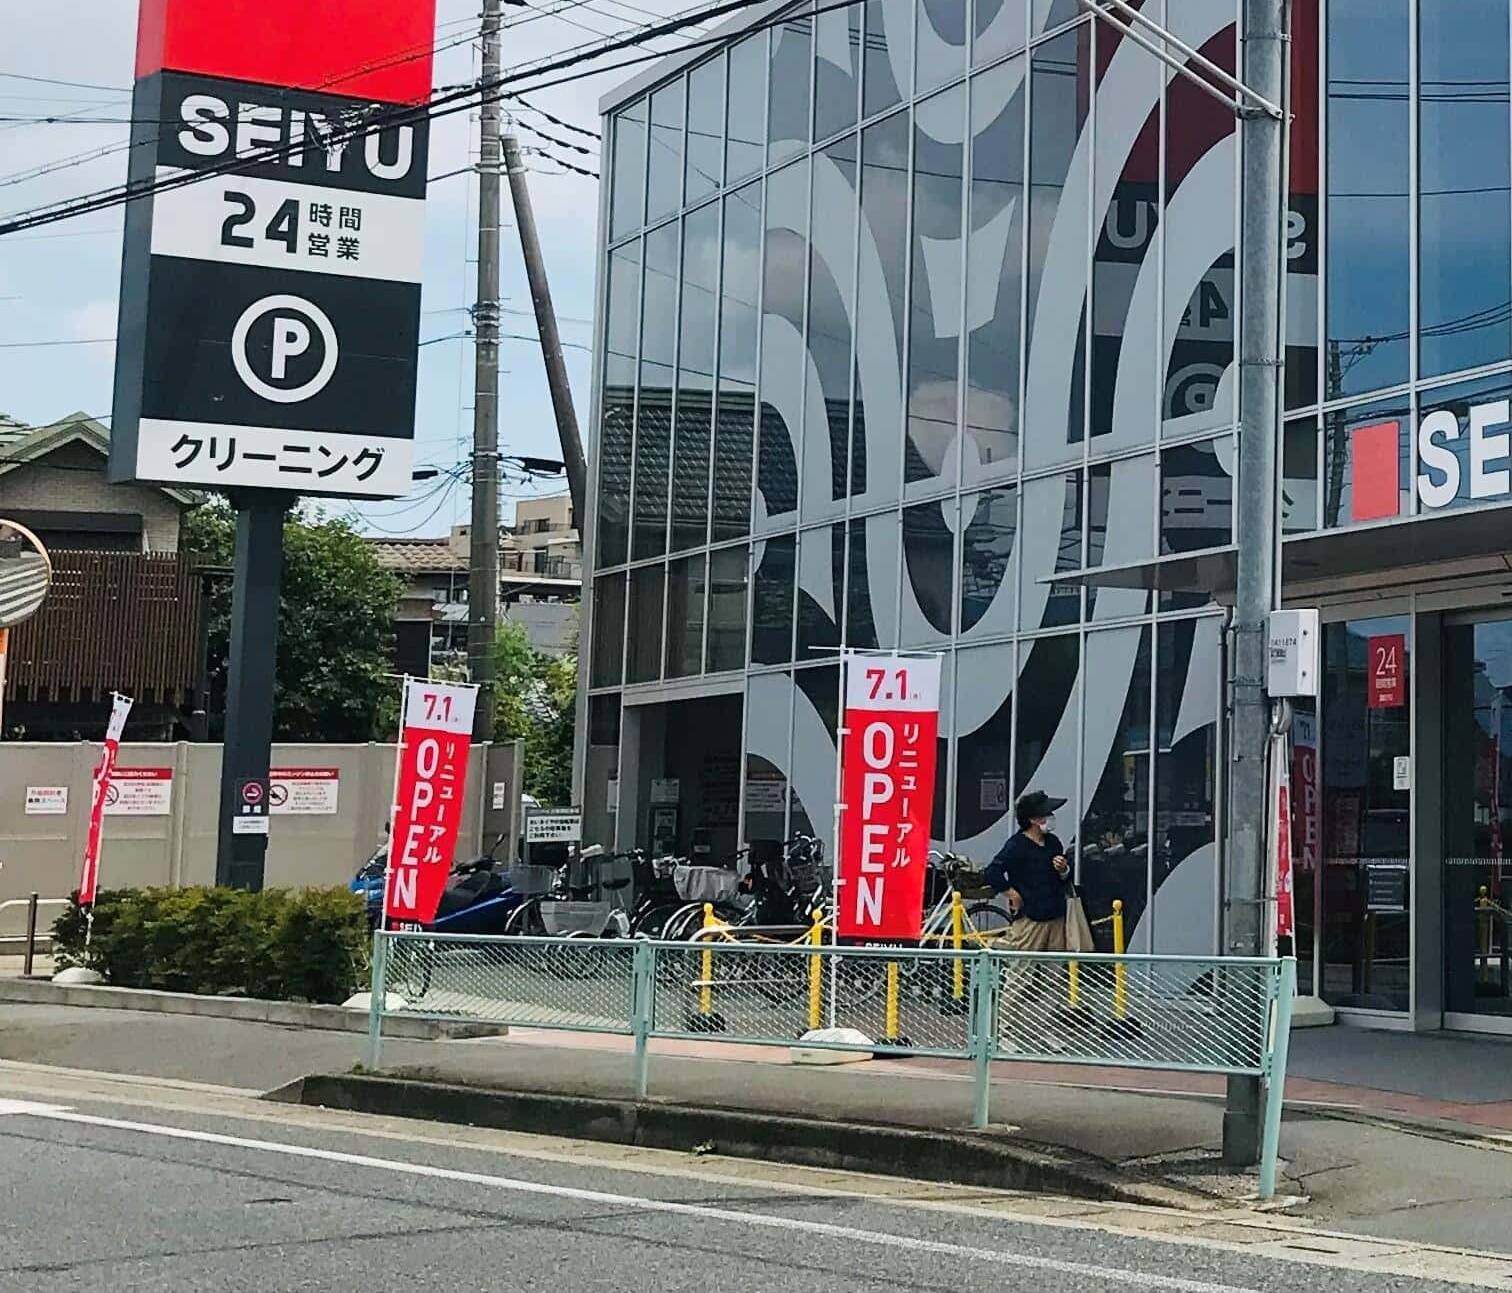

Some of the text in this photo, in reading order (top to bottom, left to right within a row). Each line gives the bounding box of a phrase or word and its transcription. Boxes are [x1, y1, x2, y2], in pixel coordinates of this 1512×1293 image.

[178, 94, 415, 181] SEIYU
[220, 191, 300, 255] 24
[308, 233, 360, 261] 営業
[309, 202, 362, 232] 時間
[271, 316, 311, 380] P
[170, 433, 386, 483] クリーニング
[1376, 646, 1398, 676] 24
[391, 737, 441, 910] OPEN
[421, 740, 457, 864] リニューアル
[854, 721, 895, 926] OPEN
[891, 723, 920, 869] リニューアル
